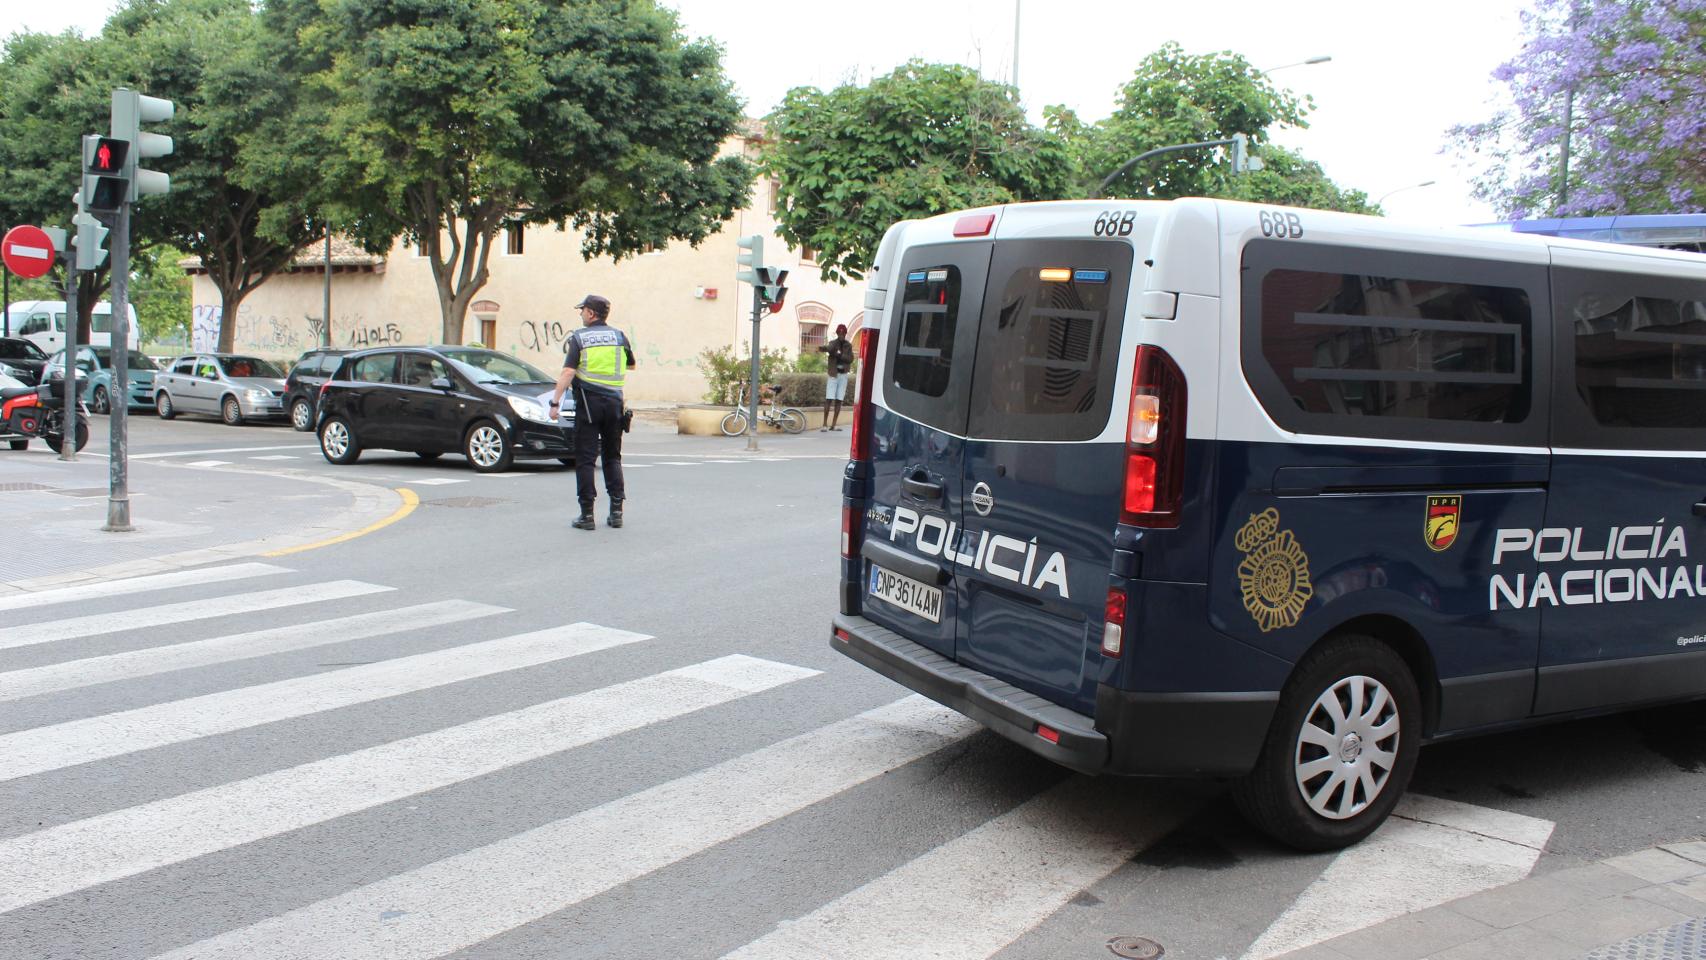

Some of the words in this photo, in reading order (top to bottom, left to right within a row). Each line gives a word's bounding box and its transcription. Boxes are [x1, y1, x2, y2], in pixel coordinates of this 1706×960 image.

[1093, 210, 1137, 237] 68B
[1259, 209, 1304, 239] 68B
[889, 505, 1070, 599] POLICÍA
[1492, 516, 1688, 565] POLICÍA
[876, 570, 940, 617] CNP3614AW
